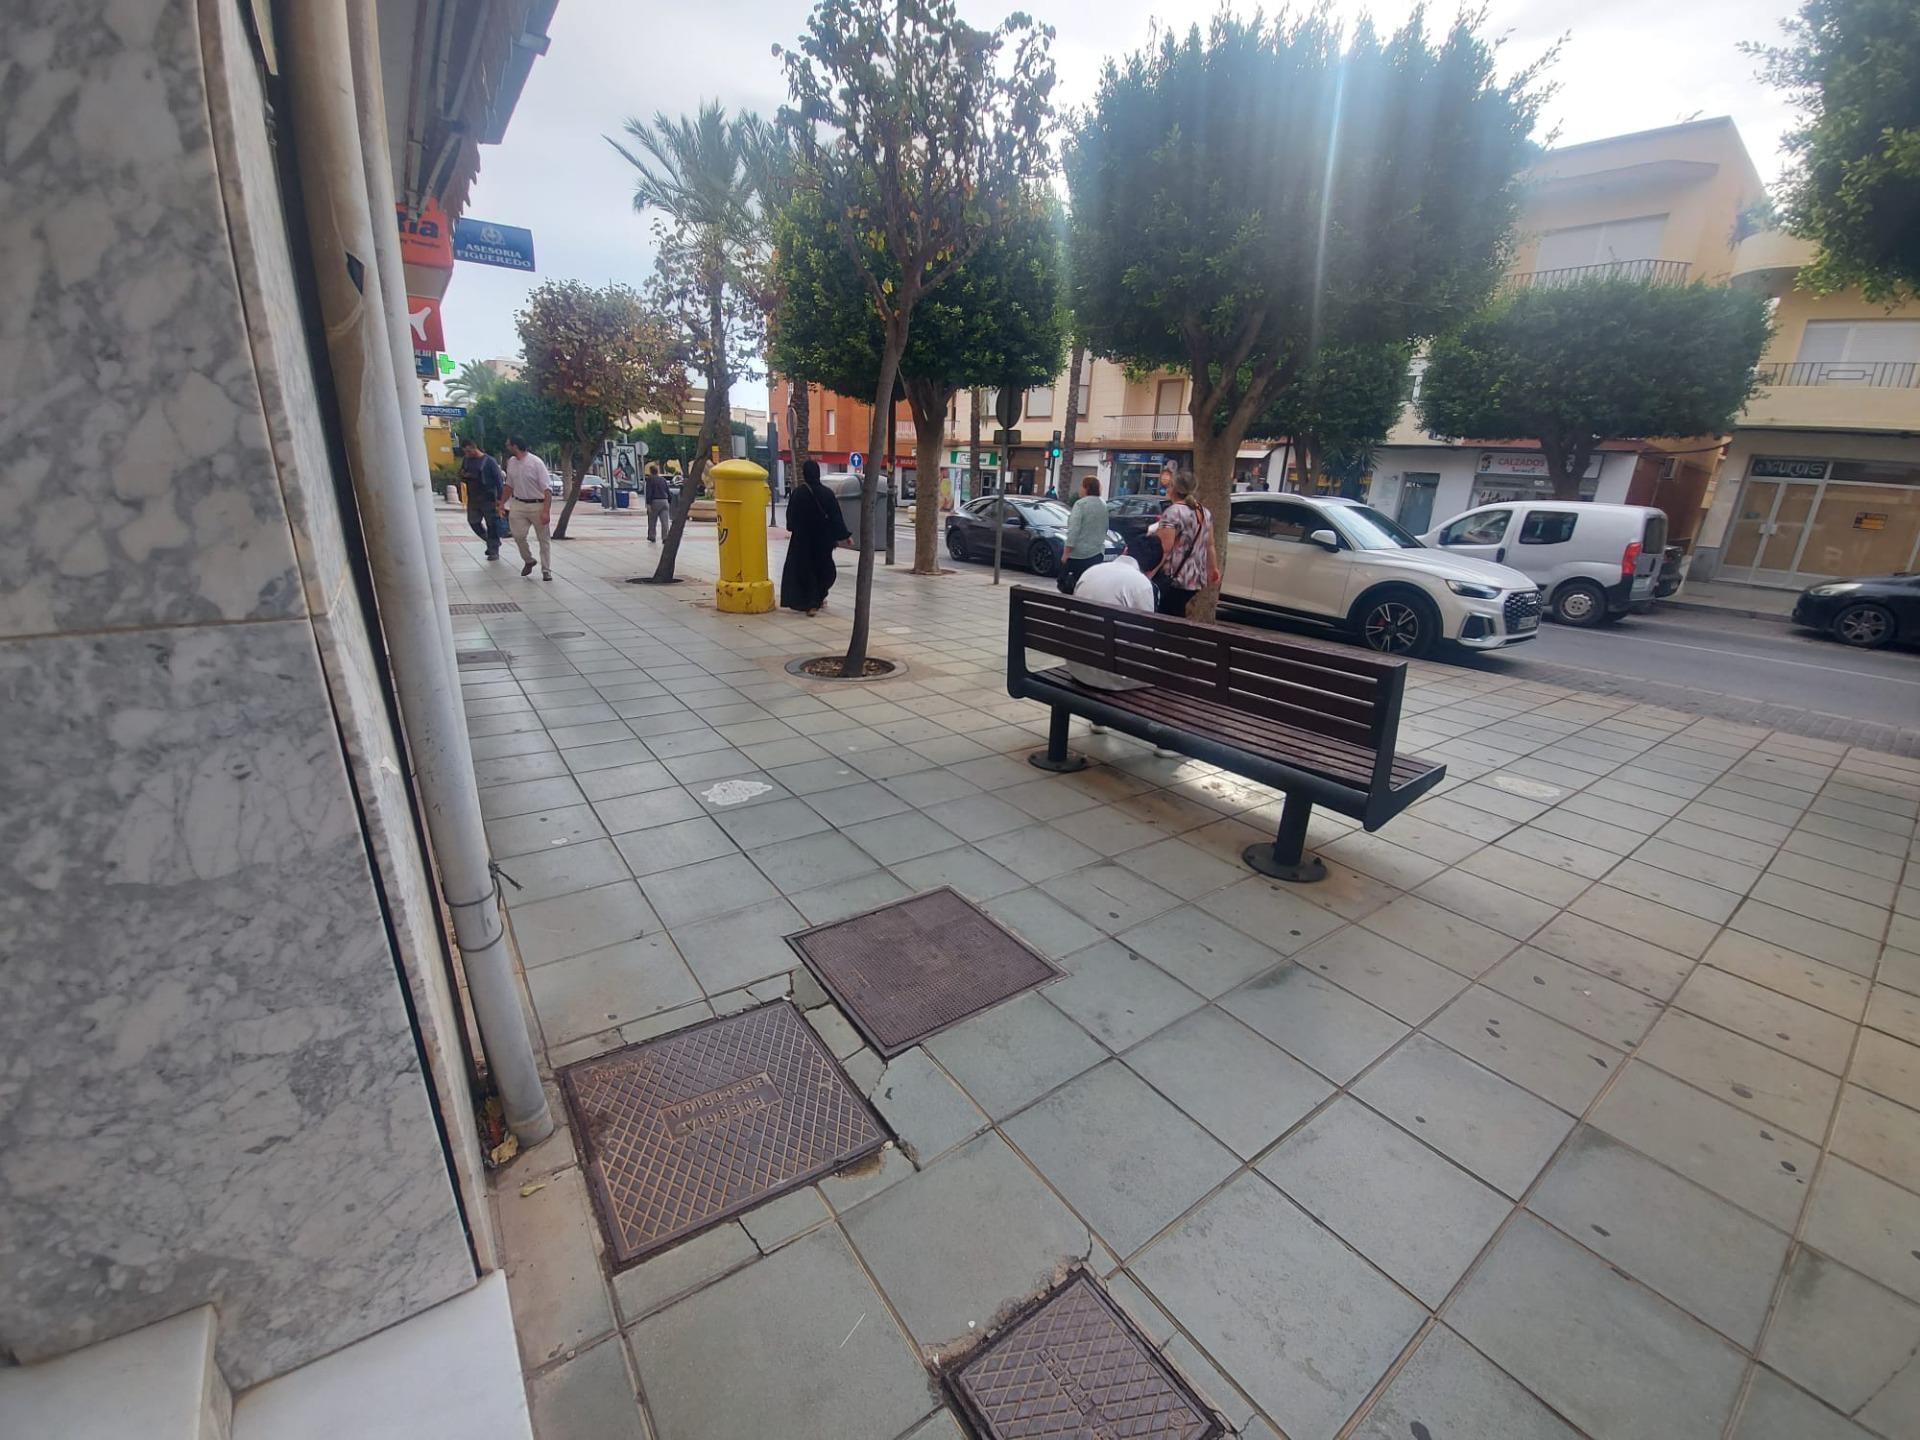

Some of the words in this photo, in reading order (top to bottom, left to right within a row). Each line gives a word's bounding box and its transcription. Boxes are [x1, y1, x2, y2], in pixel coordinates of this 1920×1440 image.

[456, 249, 532, 268] FIGUEREDO
[465, 243, 522, 259] ASESORIA
[1498, 456, 1545, 467] CALZADOS
[685, 1096, 763, 1131] ENERGIA
